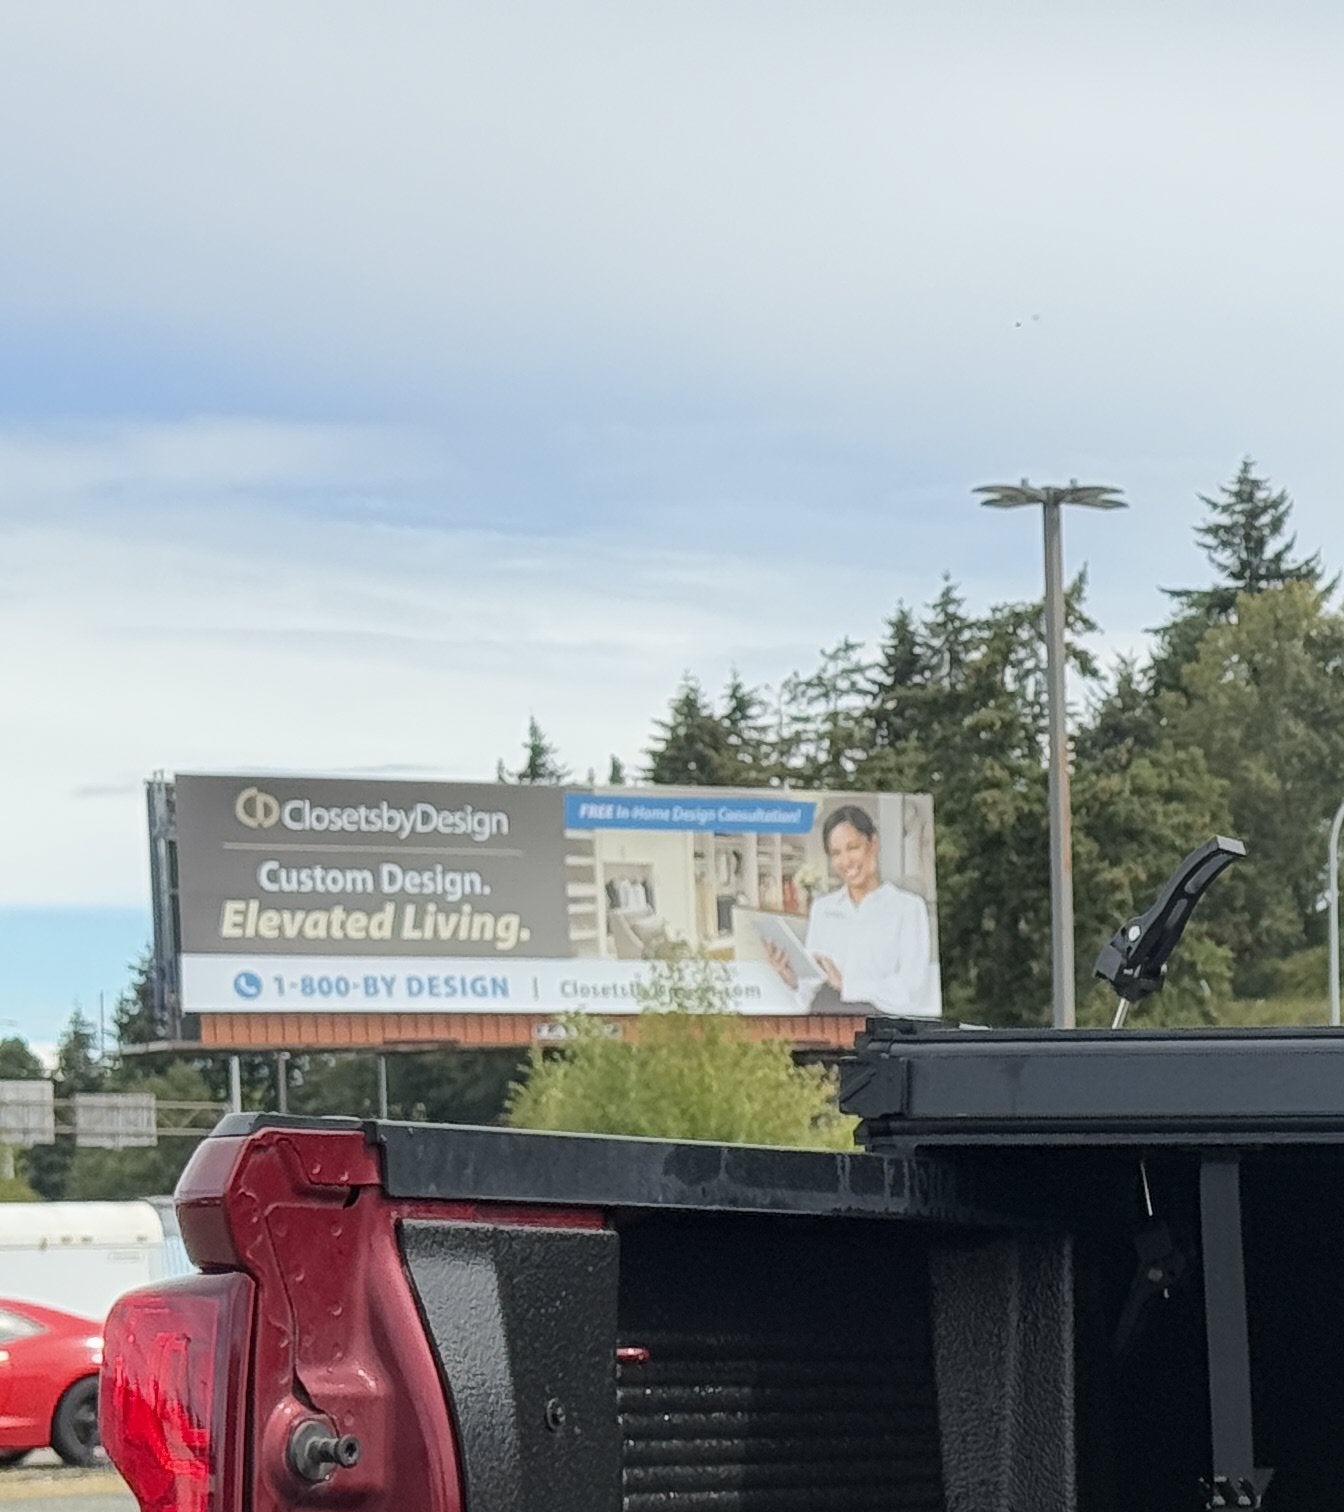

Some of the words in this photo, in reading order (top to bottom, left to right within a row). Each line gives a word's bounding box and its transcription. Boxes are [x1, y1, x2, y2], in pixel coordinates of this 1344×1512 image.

[281, 799, 510, 842] ClosetsbyDesign
[579, 802, 613, 820] FREE
[671, 804, 716, 826] Design
[256, 860, 374, 894] Custom
[379, 862, 492, 902] Design.
[220, 899, 396, 939] Elevated
[401, 902, 531, 951] Living.
[273, 975, 397, 998] 1-800-BY
[407, 975, 510, 998] DESIGN
